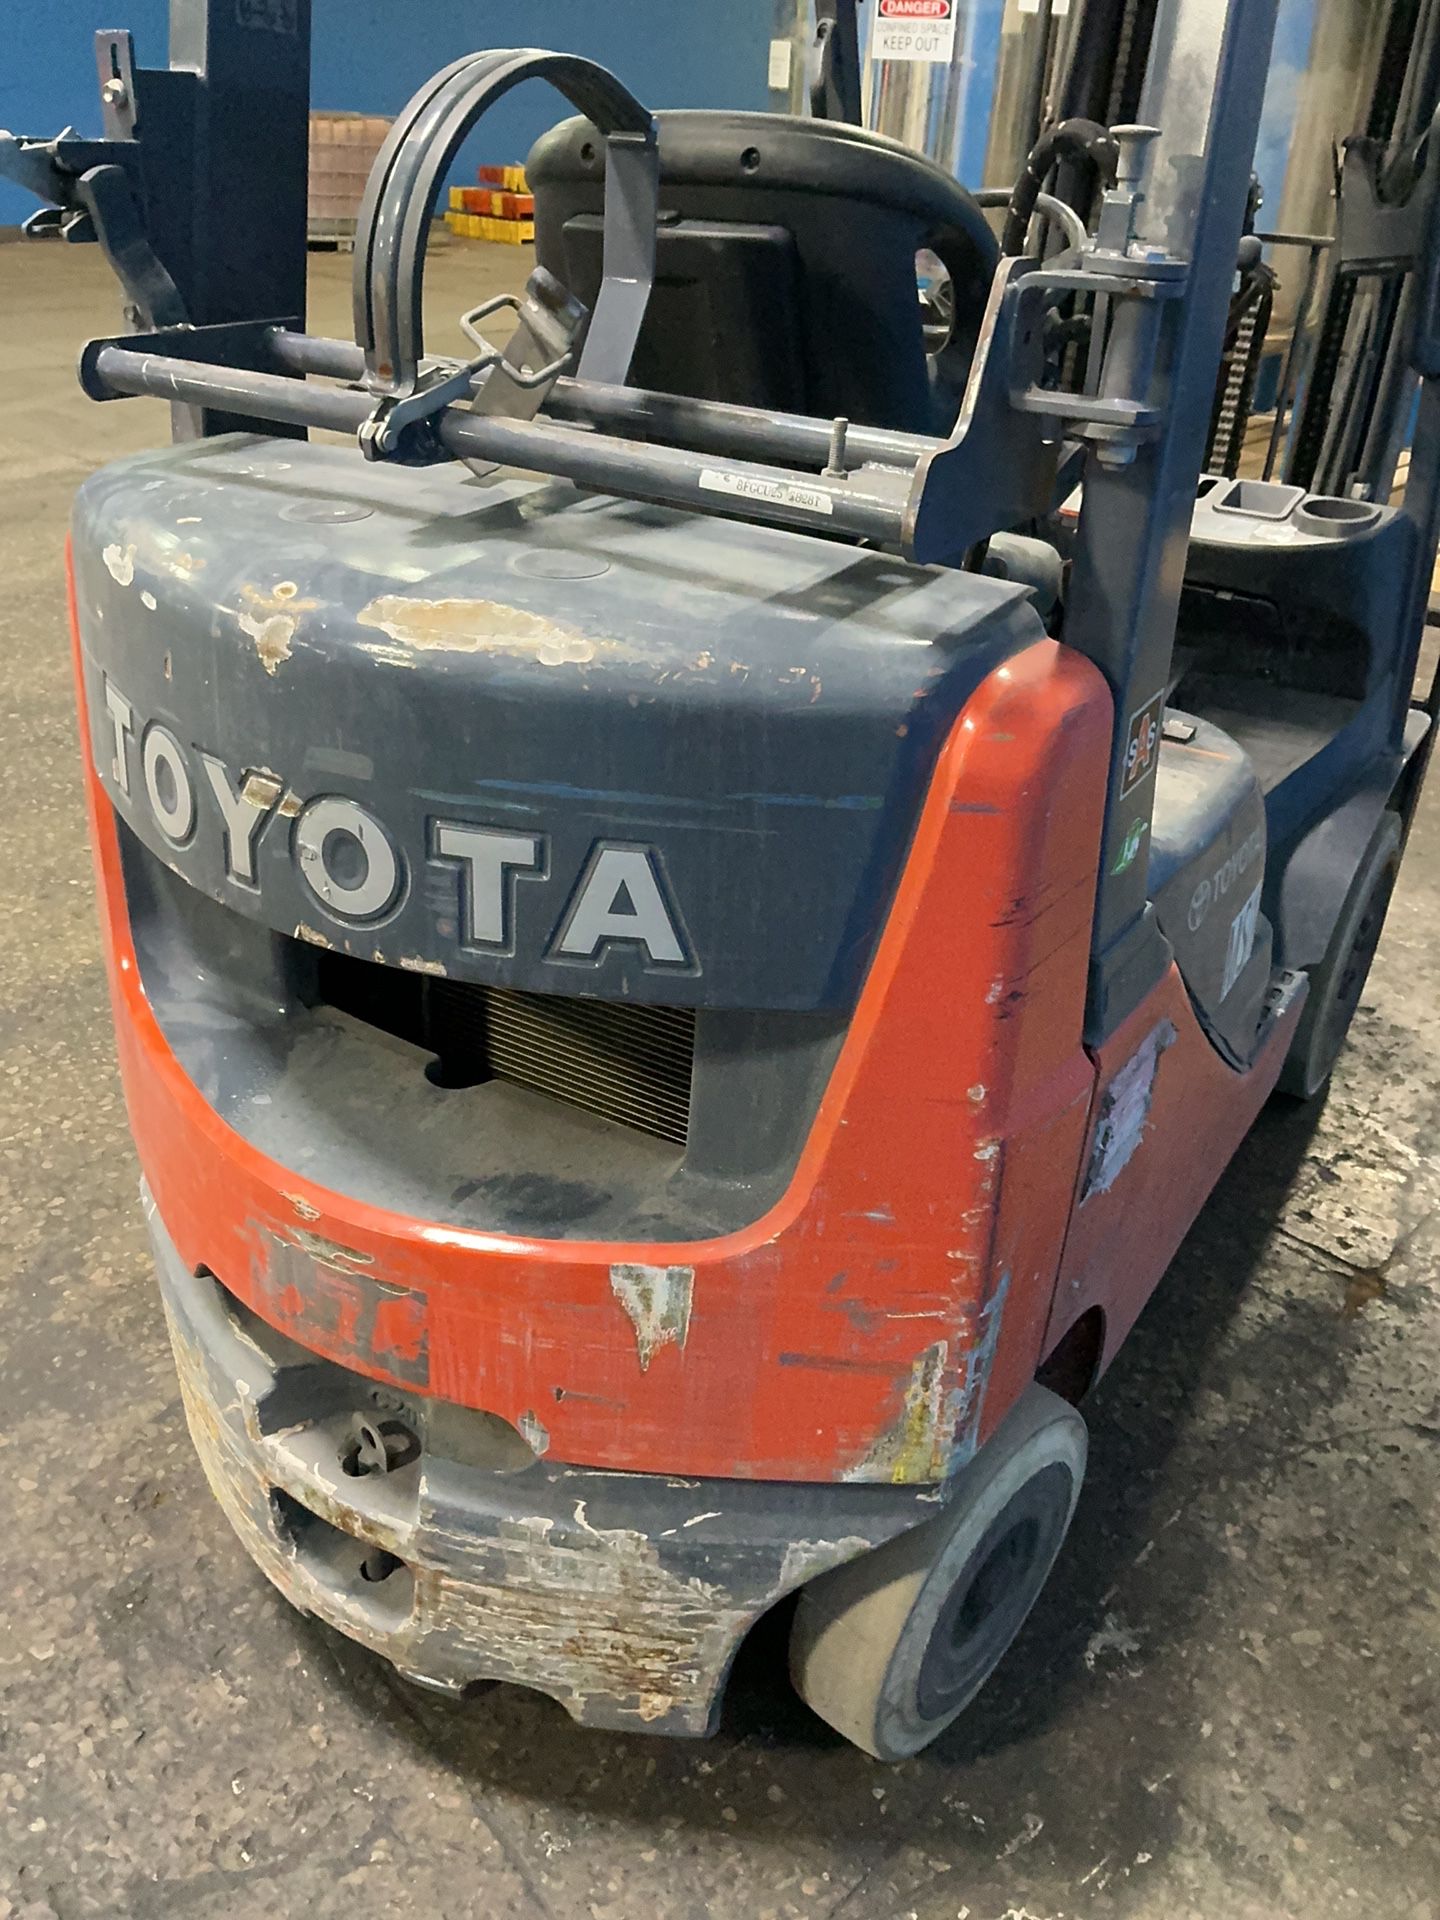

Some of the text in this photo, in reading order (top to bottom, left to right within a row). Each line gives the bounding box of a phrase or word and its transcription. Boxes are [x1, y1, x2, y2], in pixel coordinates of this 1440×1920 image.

[887, 0, 940, 14] DANGER
[883, 36, 940, 51] KEEP OUT
[1127, 711, 1157, 781] SAS
[103, 678, 699, 969] TOYOTA
[1213, 826, 1263, 902] TOYO
